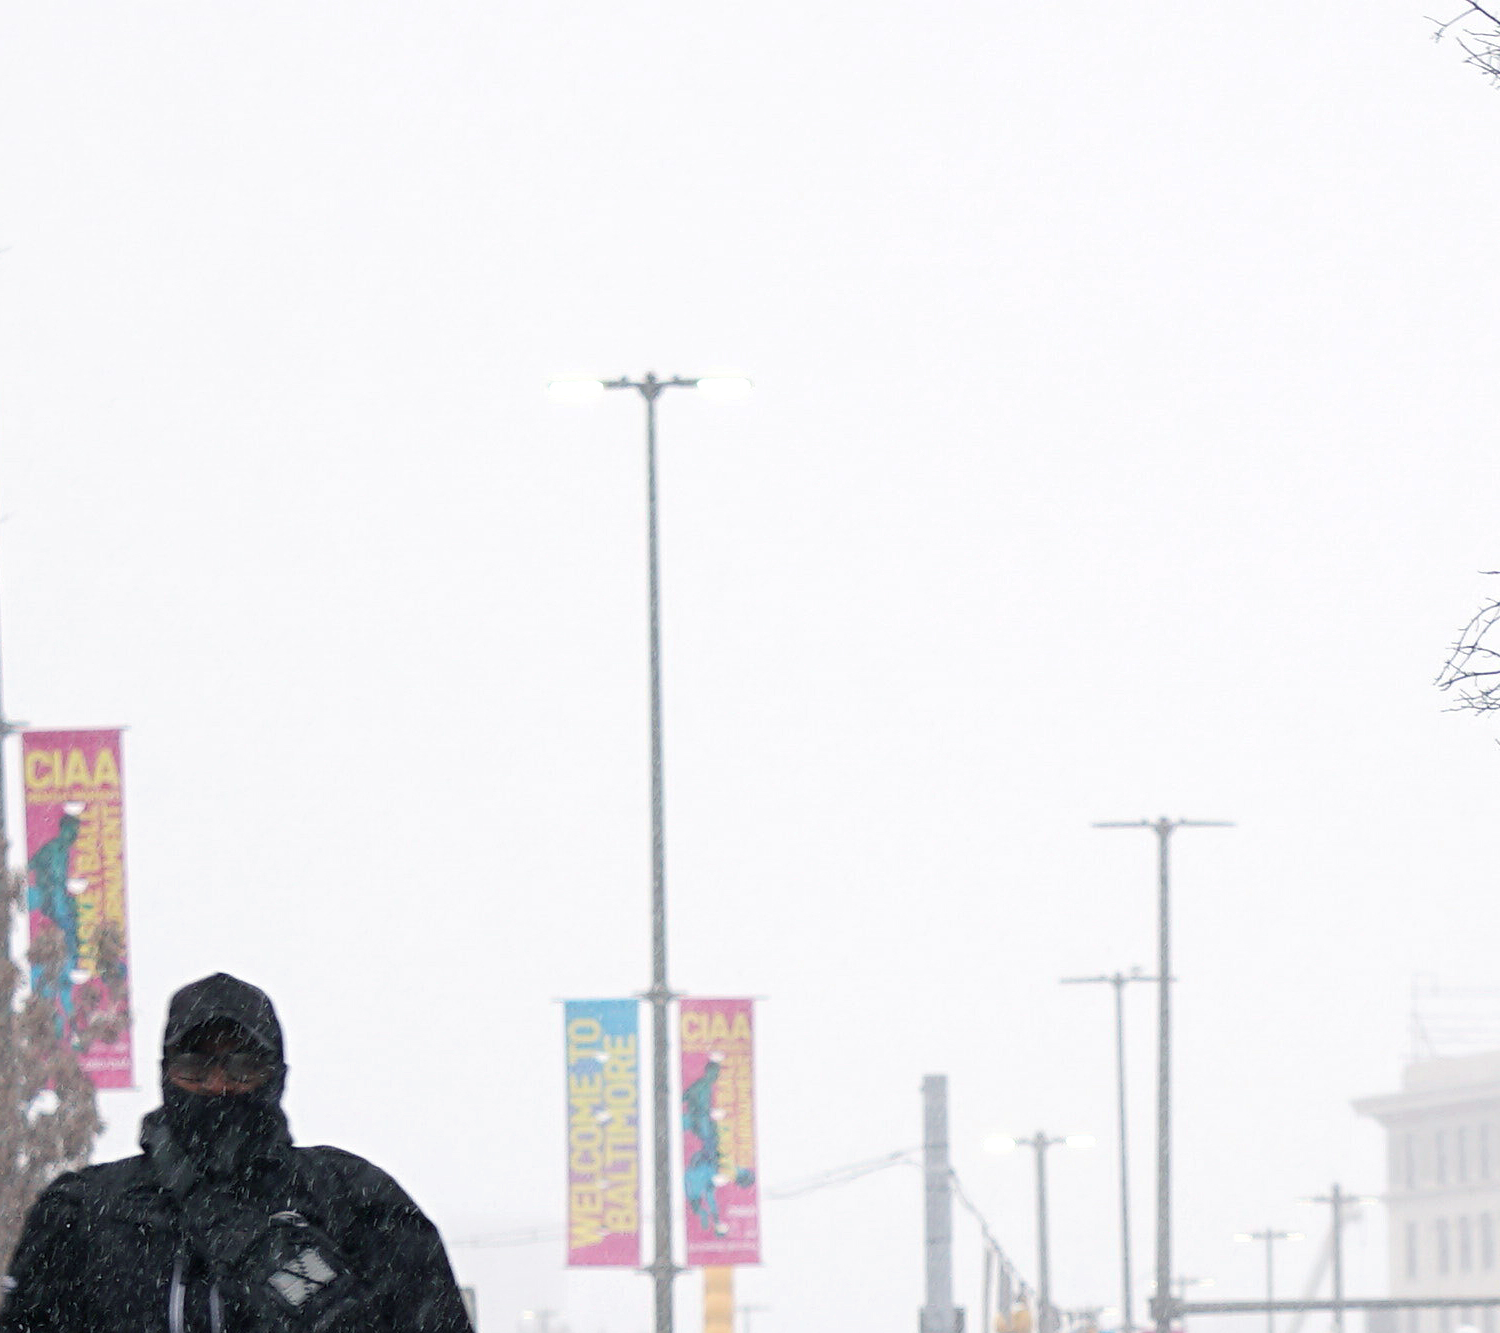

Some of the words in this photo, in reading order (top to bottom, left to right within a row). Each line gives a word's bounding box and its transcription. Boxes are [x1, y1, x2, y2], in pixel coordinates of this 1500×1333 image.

[26, 747, 119, 788] CIAA
[567, 1018, 600, 1066] TO
[681, 1010, 751, 1042] CIAA
[603, 1033, 639, 1234] BALTIMORE
[568, 1073, 601, 1249] WELCOME
